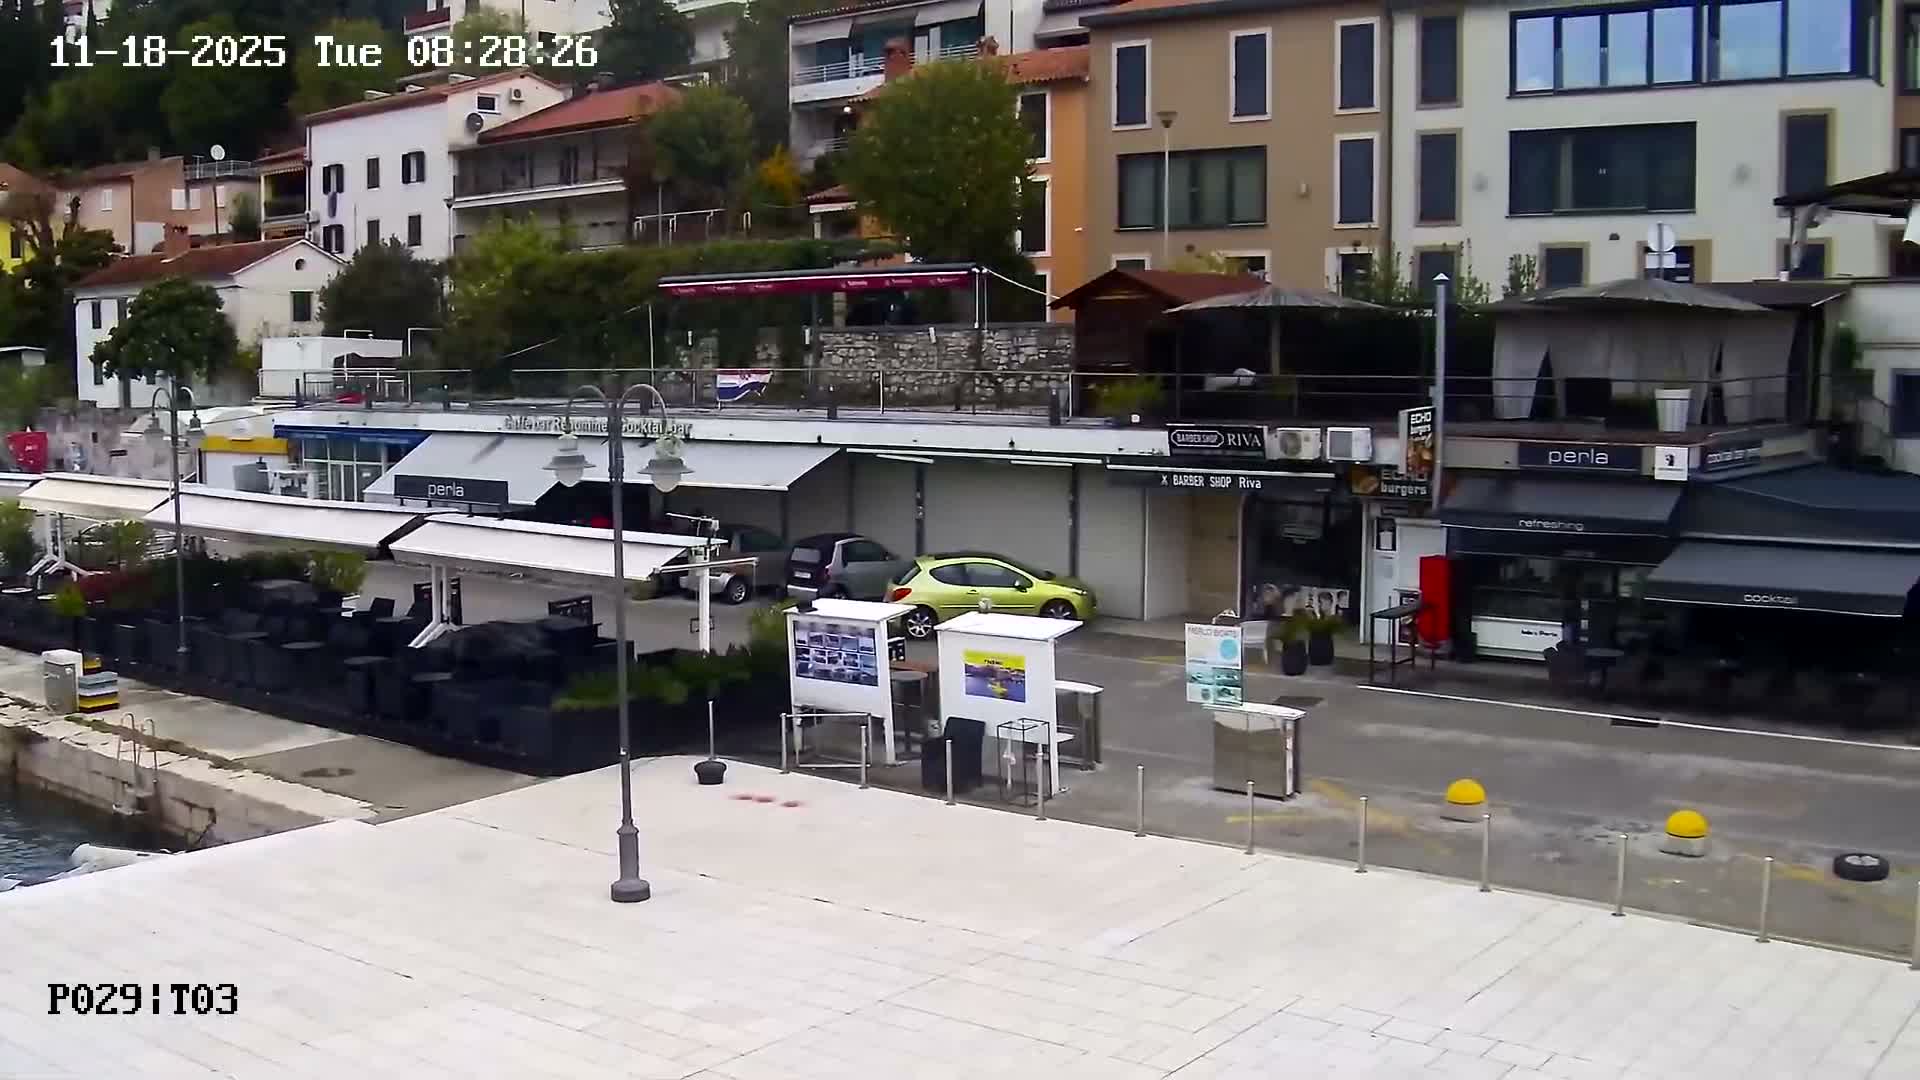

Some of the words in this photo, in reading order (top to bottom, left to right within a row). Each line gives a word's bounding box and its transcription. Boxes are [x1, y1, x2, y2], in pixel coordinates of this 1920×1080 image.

[1410, 411, 1432, 424] ECHO
[1227, 433, 1261, 447] RIVA
[1549, 448, 1609, 465] perla
[1172, 474, 1205, 487] BARBER
[1209, 476, 1232, 488] SHOP
[1239, 476, 1262, 489] Riva
[1381, 481, 1427, 497] burgers
[428, 481, 464, 498] perla
[1519, 519, 1584, 531] refreshing
